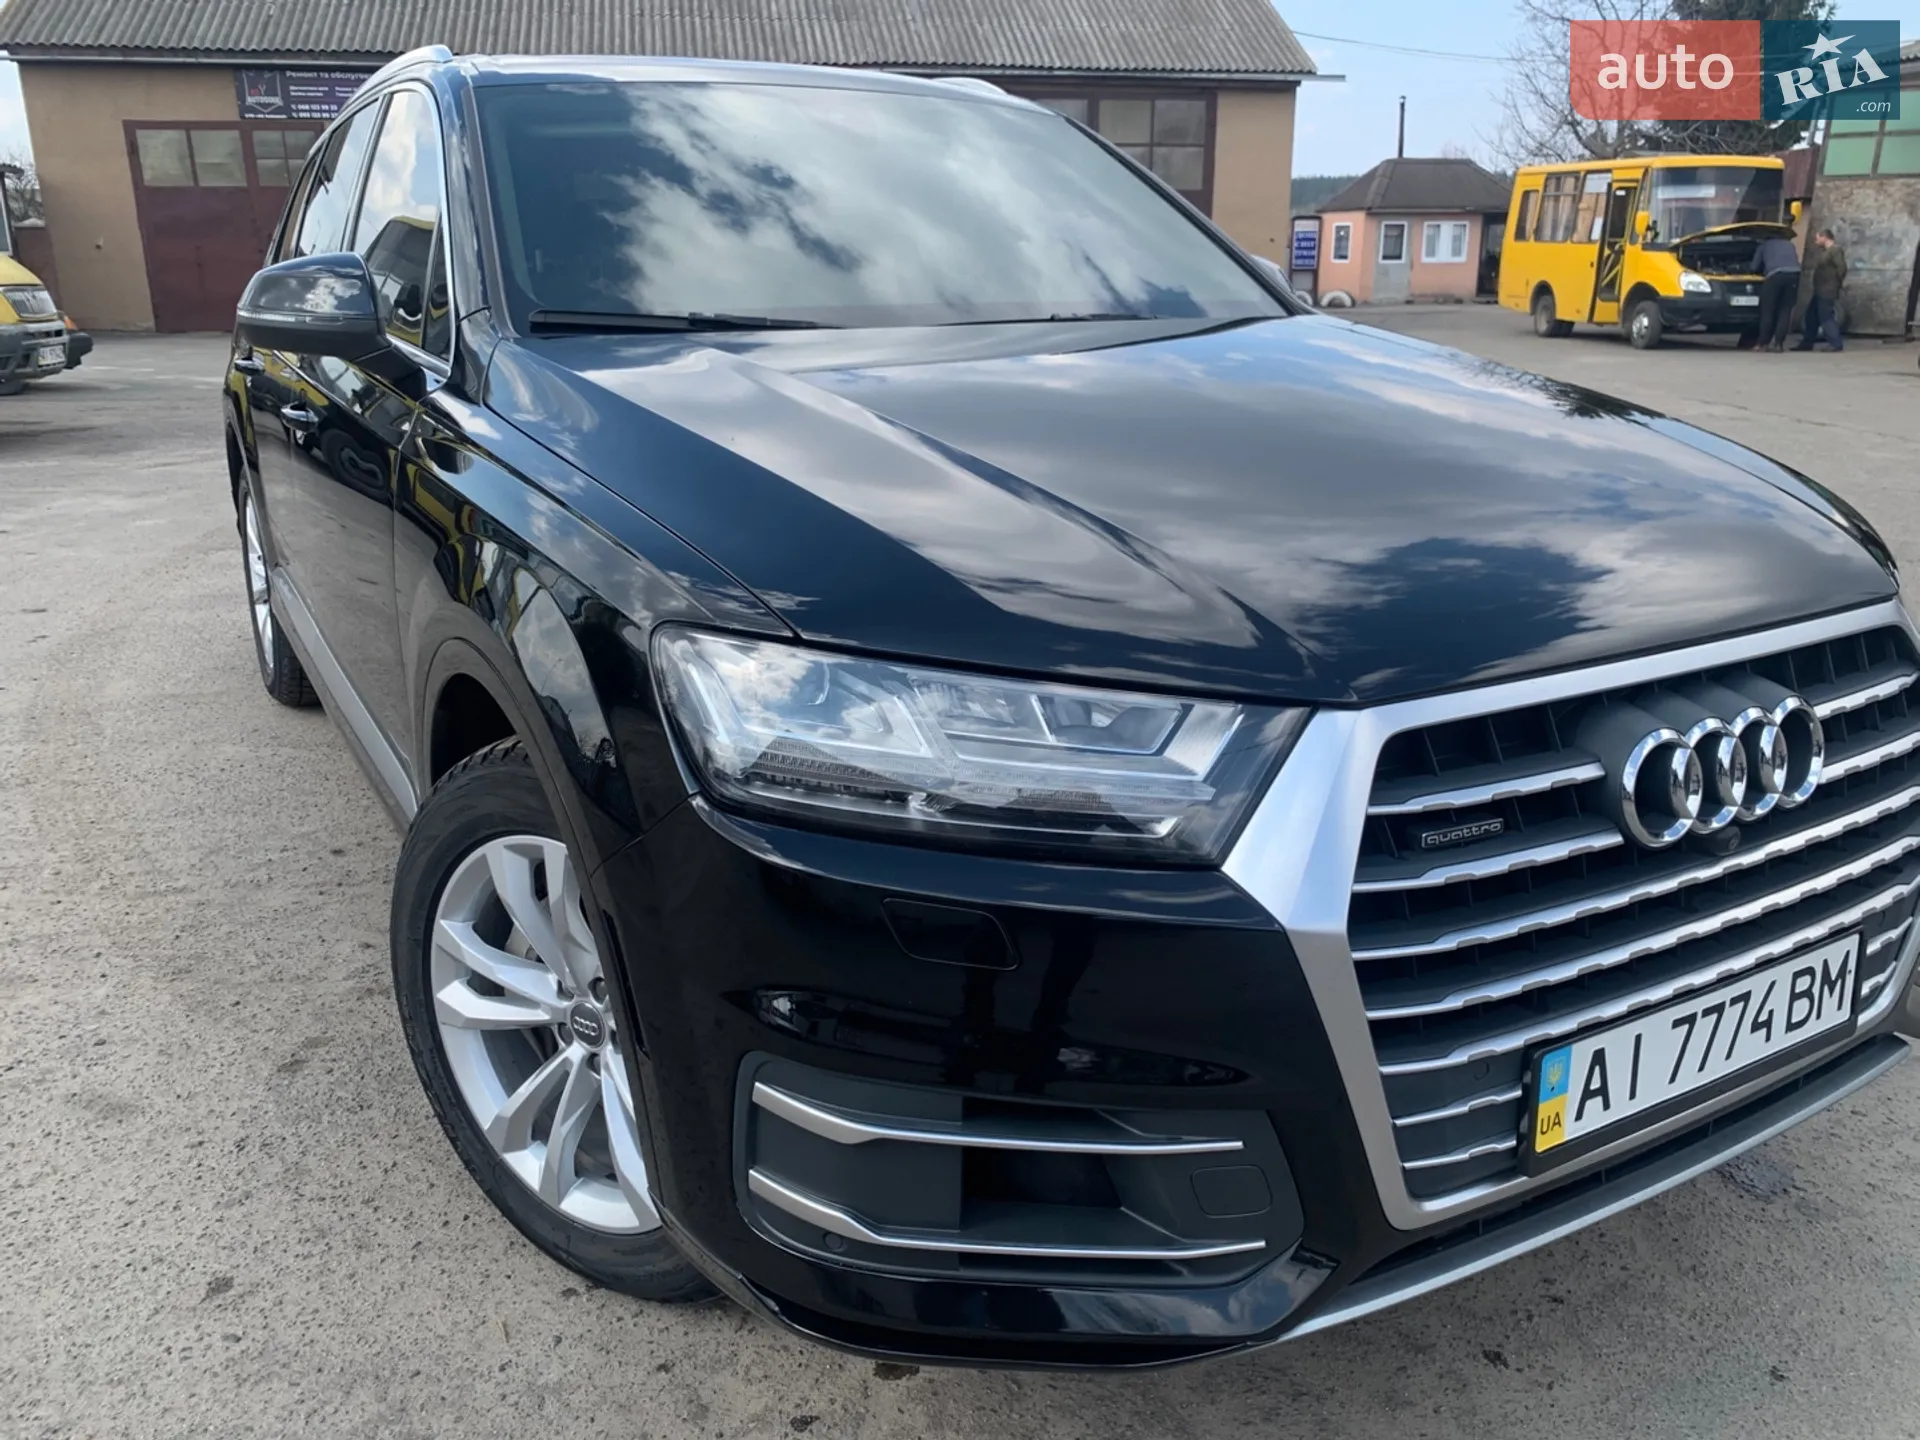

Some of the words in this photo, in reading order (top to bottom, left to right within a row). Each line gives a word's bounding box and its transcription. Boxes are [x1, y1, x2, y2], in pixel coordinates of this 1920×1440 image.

[1427, 822, 1501, 845] quattro
[1574, 1033, 1642, 1122] AI
[1668, 979, 1777, 1085] 7774
[1785, 949, 1851, 1034] BM
[1540, 1111, 1562, 1135] UA
